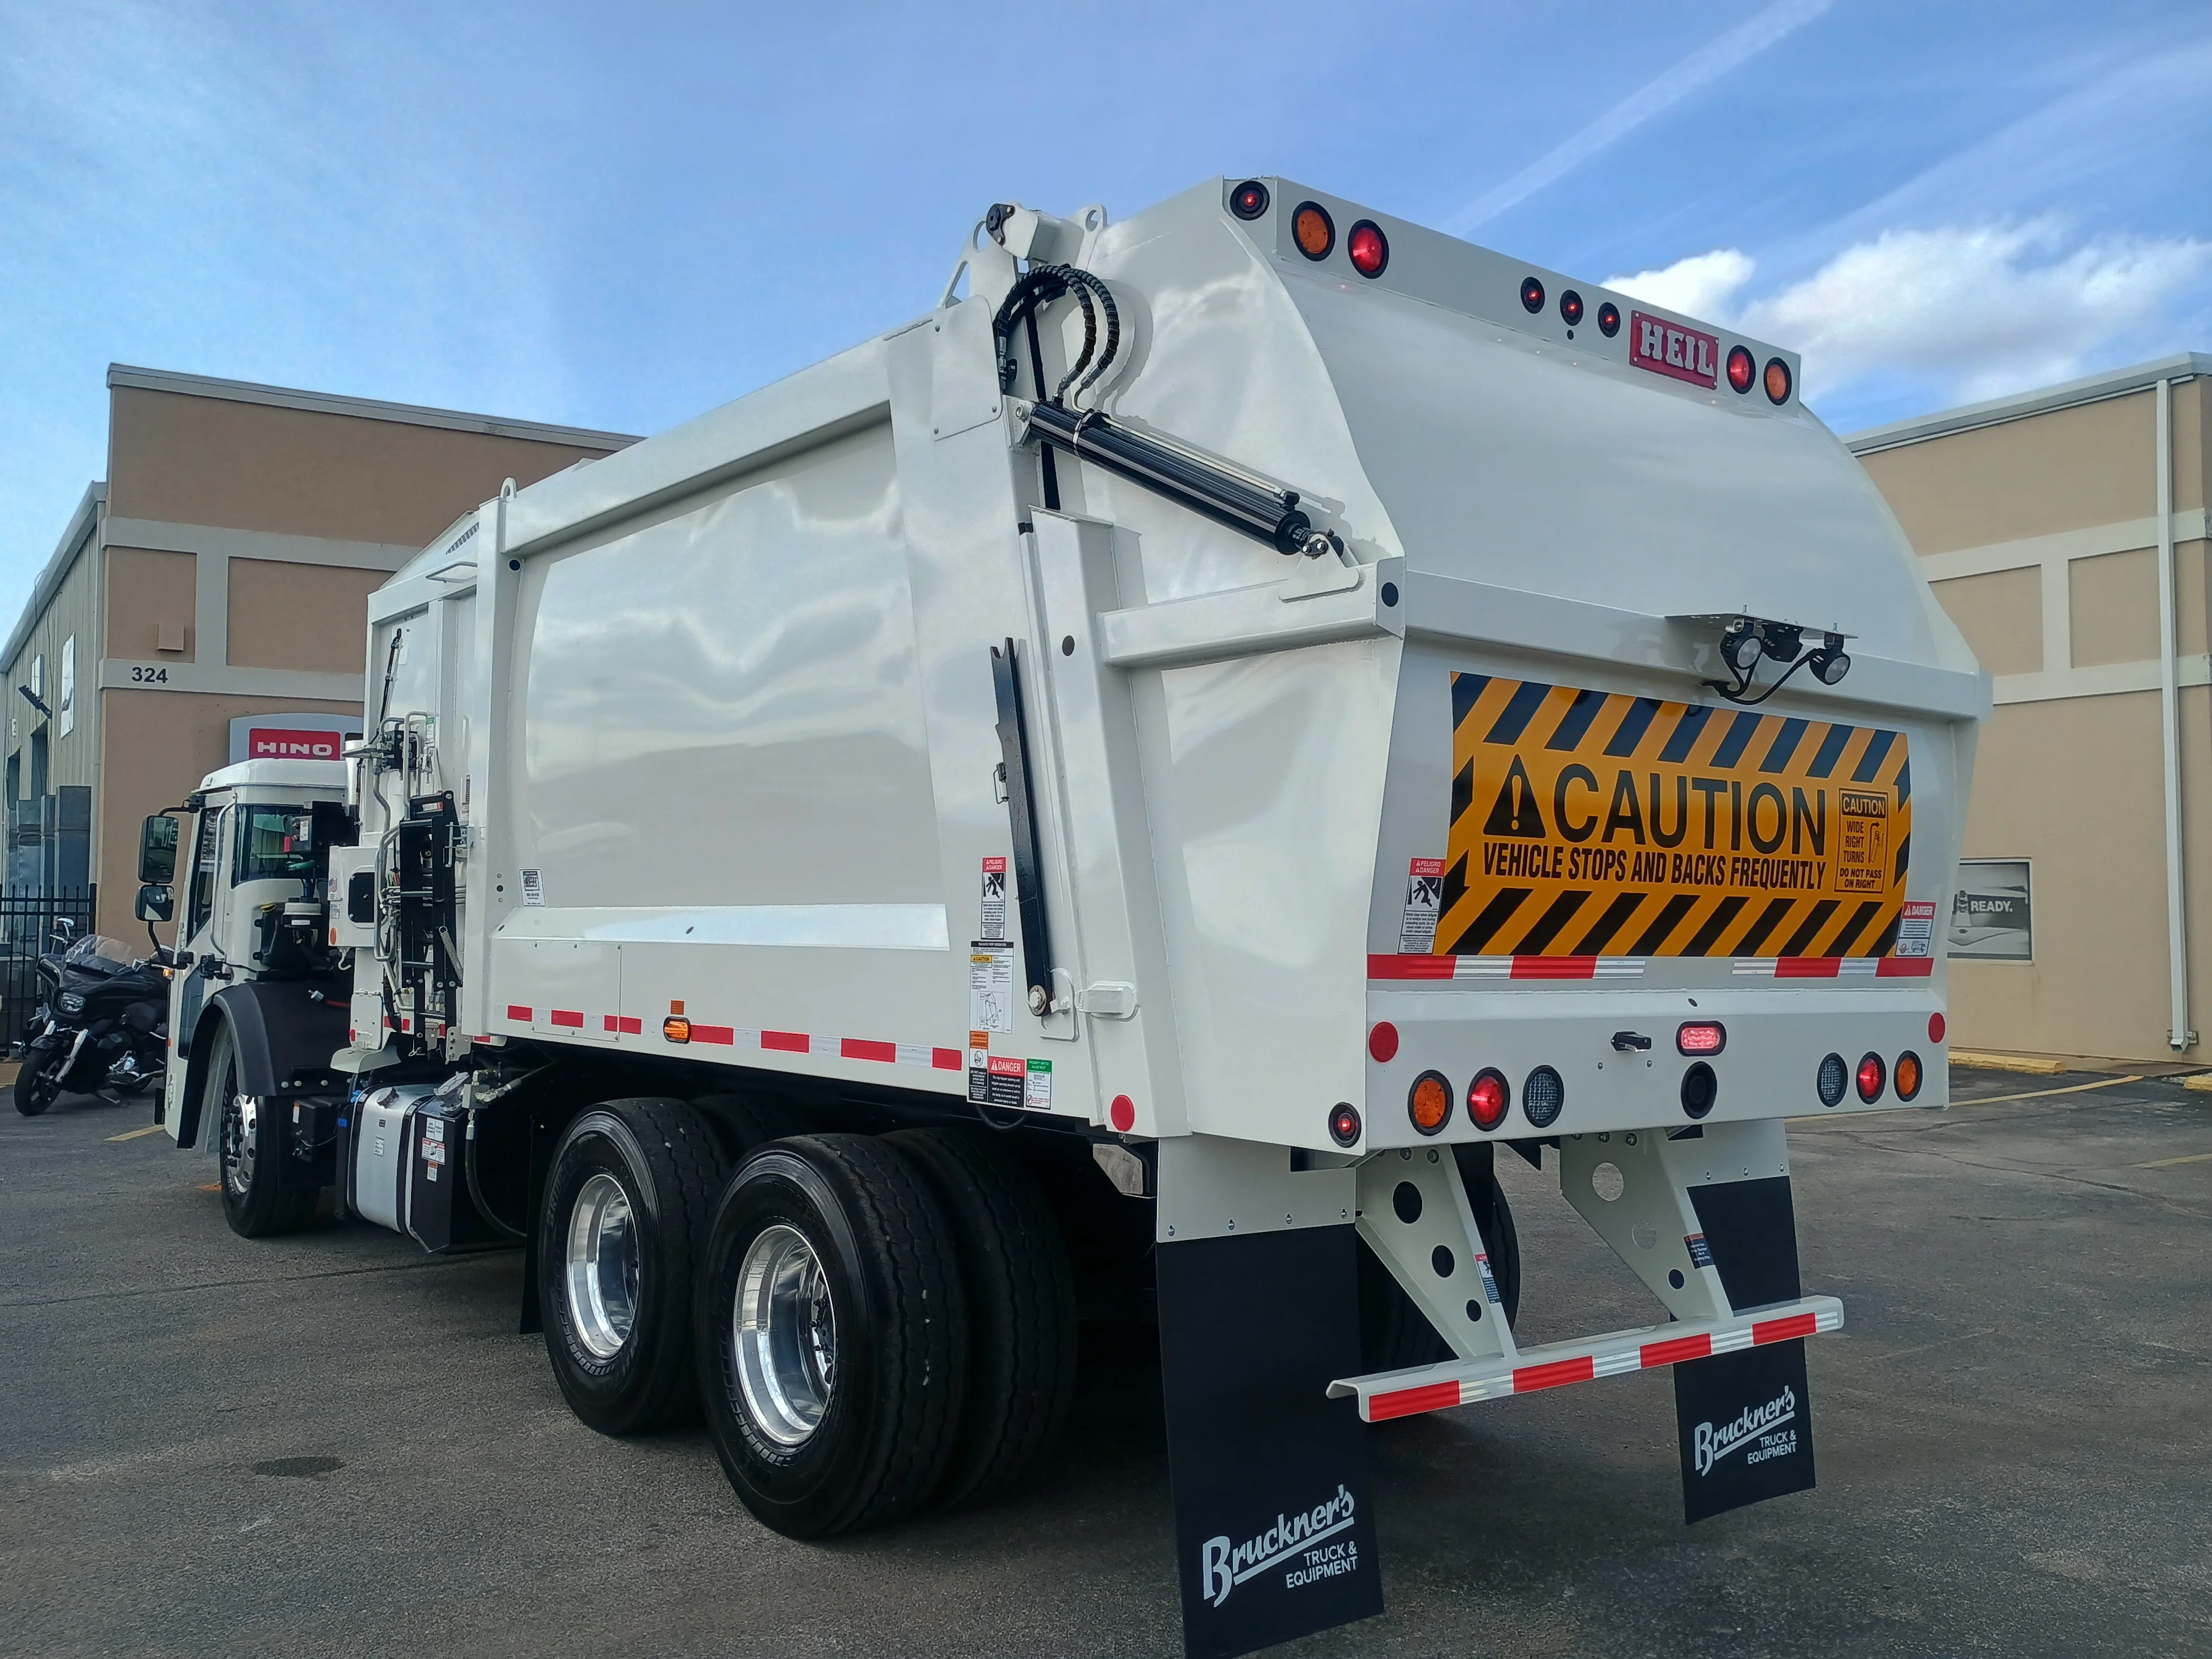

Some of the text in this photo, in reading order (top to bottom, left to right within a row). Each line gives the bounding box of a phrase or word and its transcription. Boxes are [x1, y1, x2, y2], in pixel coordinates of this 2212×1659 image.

[1640, 321, 1715, 377] HEIL
[132, 666, 168, 683] 324
[257, 741, 332, 756] HINO
[1553, 763, 1825, 856] CAUTION
[1843, 797, 1885, 815] CAUTION
[1846, 820, 1864, 833] WIDE
[1845, 835, 1865, 848] RIGHT
[1843, 850, 1865, 864] TURNS
[1483, 841, 1826, 891] VEHICLE STOPS AND BACKS FREQUENTLY
[1840, 868, 1882, 879] DO NOT PASS
[1844, 879, 1876, 889] ON RIGHT
[1912, 906, 1933, 916] DANGER
[1971, 901, 2013, 912] READY.
[998, 1061, 1021, 1073] DANGER
[1694, 1385, 1795, 1476] Bruckner's
[1759, 1429, 1796, 1448] TRUCK &
[1748, 1441, 1797, 1464] EQUIPMENT
[1203, 1484, 1355, 1608] Bruckner's
[1304, 1541, 1358, 1567] TRUCK &
[1286, 1556, 1358, 1589] EQUIPMENT
